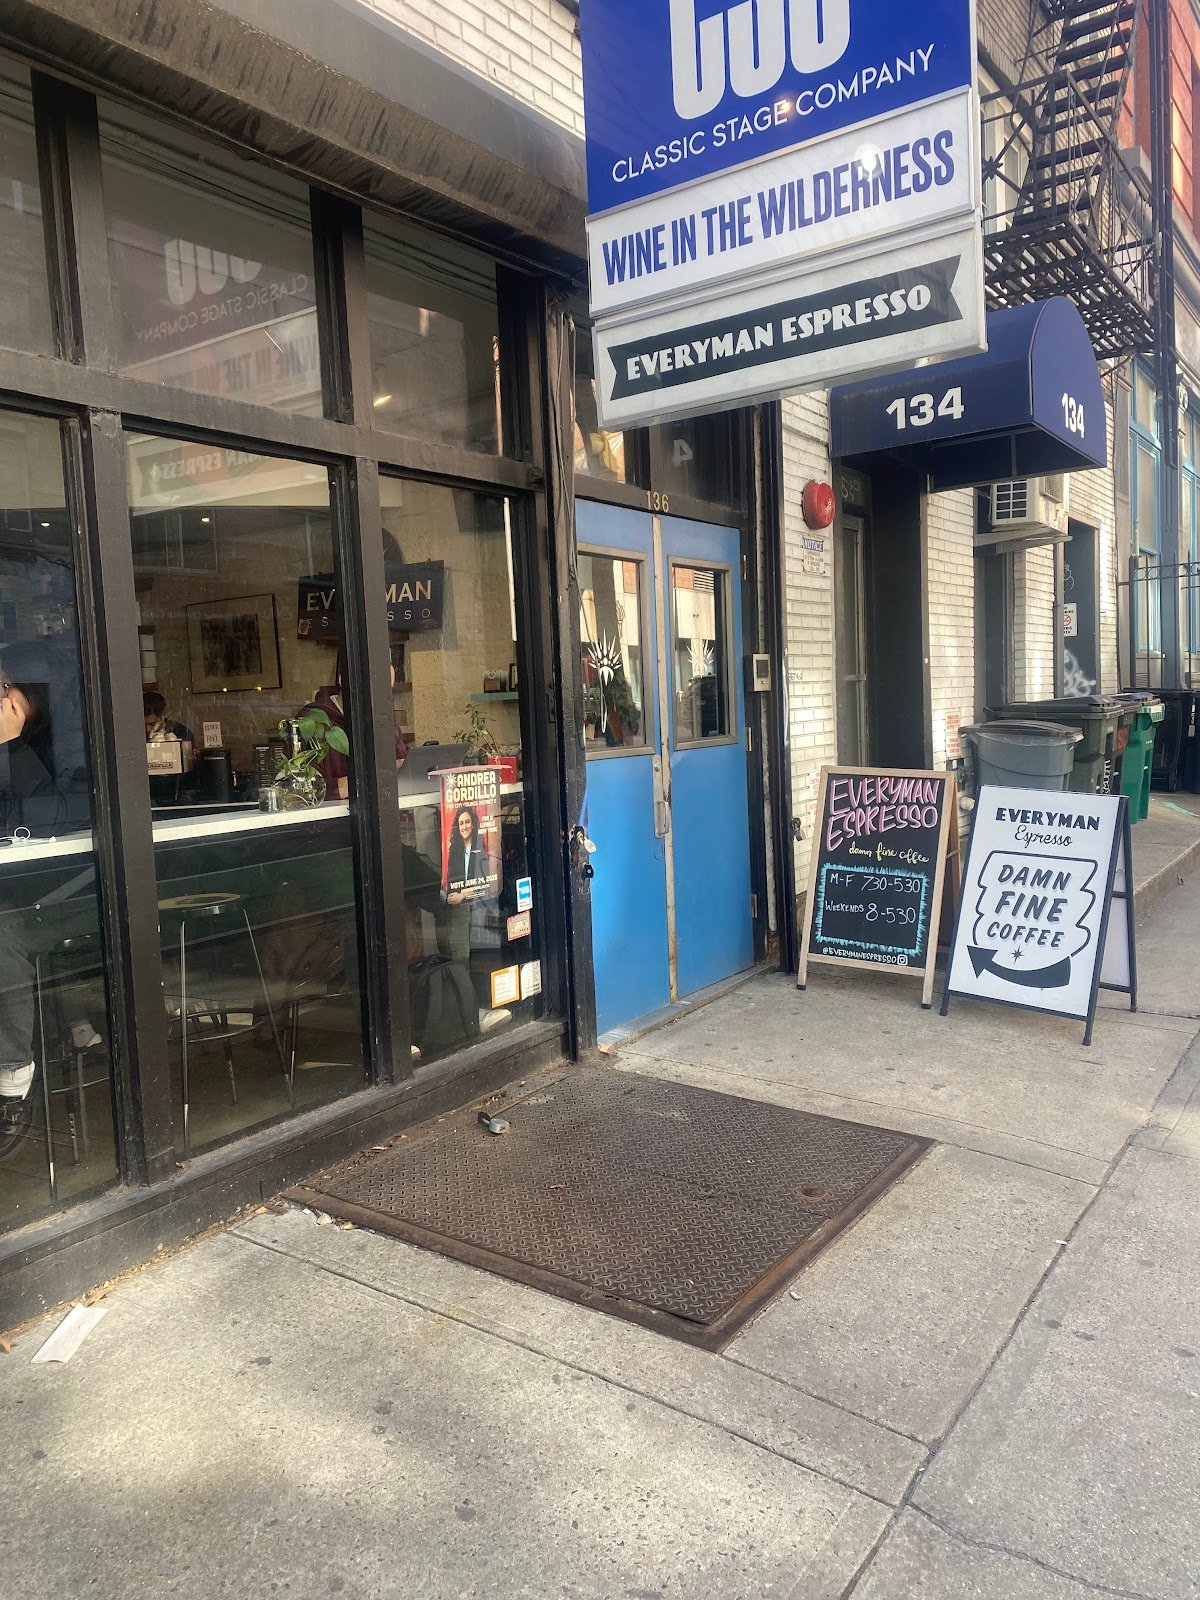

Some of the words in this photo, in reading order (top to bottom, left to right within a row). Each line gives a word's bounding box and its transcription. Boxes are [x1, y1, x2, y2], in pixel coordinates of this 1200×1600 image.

[612, 131, 706, 184] CLASSIC
[712, 98, 789, 148] STAGE
[795, 43, 935, 117] COMPANY
[602, 224, 667, 286] WINE
[671, 213, 697, 267] IN
[701, 196, 753, 256] THE
[757, 129, 955, 240] WILDERNESS
[626, 322, 774, 380] EVERYMAN
[781, 284, 932, 344] ESPRESSO
[885, 387, 965, 430] 134
[1061, 392, 1086, 438] 134
[646, 490, 670, 513] 136
[306, 579, 432, 612] EVMAN
[457, 771, 496, 788] ANDREA
[446, 784, 497, 803] GORDILLO
[829, 777, 940, 817] EVERYMAN
[827, 804, 938, 851] ESPRESSO
[995, 807, 1100, 831] EVERYMAN
[1014, 824, 1073, 849] Espresso
[849, 841, 872, 858] damn
[876, 841, 897, 862] fine
[450, 881, 464, 890] VOTE
[465, 878, 477, 887] JUNE
[830, 873, 855, 888] M-F
[861, 875, 921, 893] 730-530
[998, 864, 1072, 892] DAMN
[866, 902, 916, 925] 8-530
[994, 891, 1068, 923] FINE
[987, 921, 1064, 948] COFFEE
[822, 947, 897, 964] @EVERYMANESPRESSO
